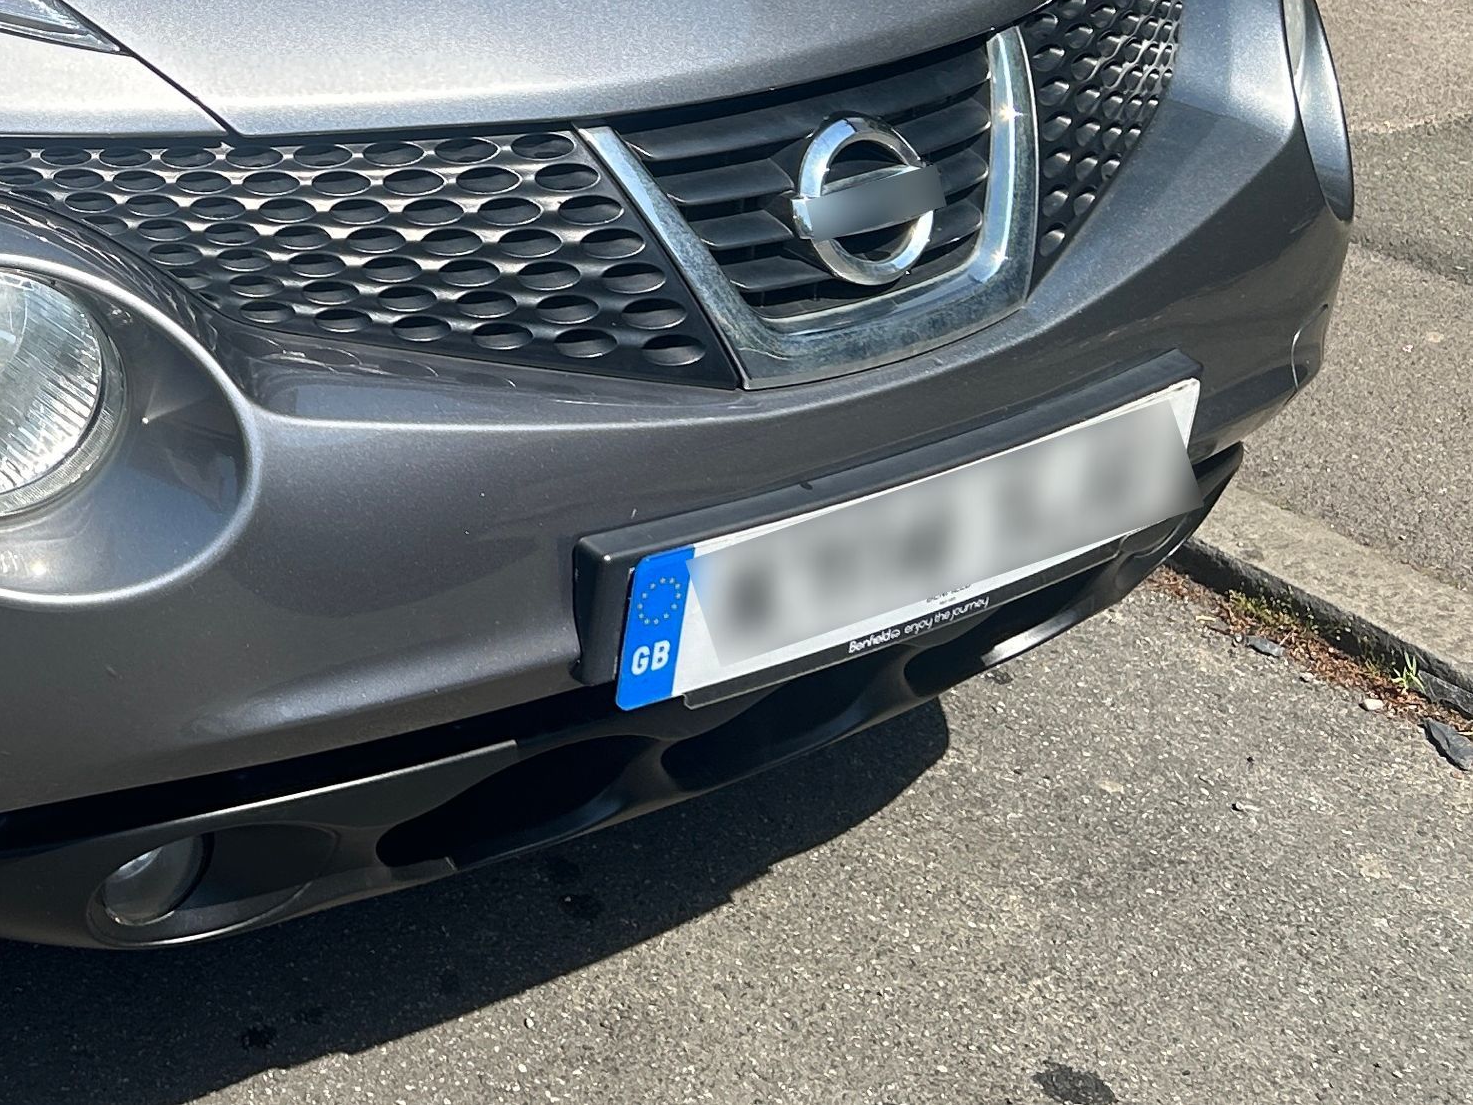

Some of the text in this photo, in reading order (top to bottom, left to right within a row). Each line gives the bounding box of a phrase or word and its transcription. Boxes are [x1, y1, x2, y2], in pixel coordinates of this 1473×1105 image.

[848, 628, 892, 654] Benfield
[904, 617, 933, 635] enjoy
[934, 610, 951, 624] the
[949, 596, 990, 621] journey
[631, 639, 671, 676] GB
